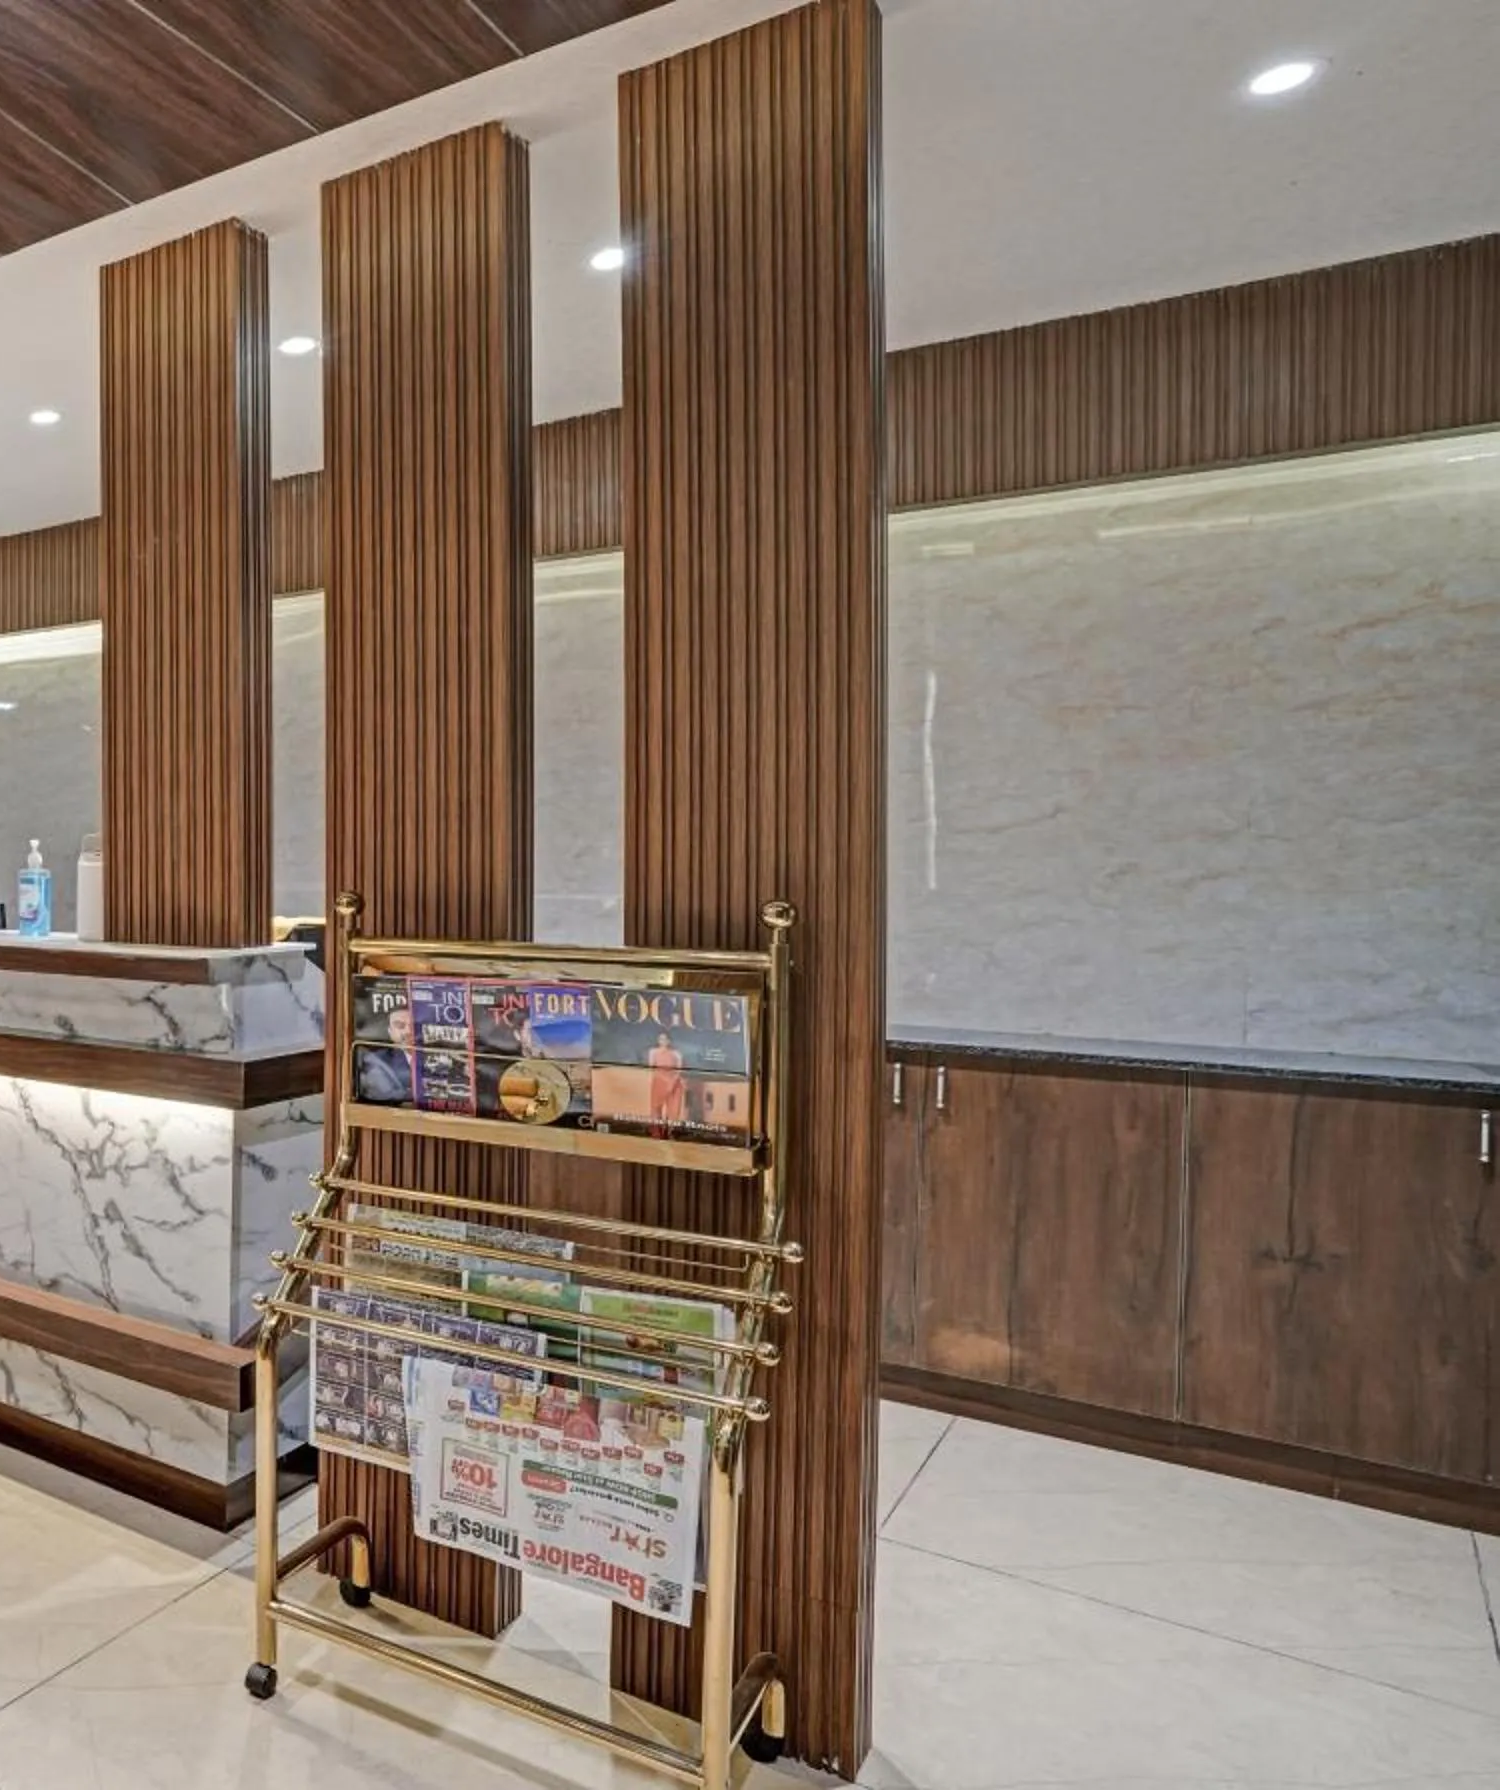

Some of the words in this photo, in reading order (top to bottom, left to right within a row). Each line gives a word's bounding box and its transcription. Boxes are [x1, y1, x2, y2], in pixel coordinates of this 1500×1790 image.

[428, 1003, 469, 1024] TO
[442, 990, 469, 1006] IN
[533, 992, 591, 1016] FORT
[595, 988, 742, 1033] VOGUE
[459, 1516, 521, 1560] Times
[523, 1539, 646, 1602] Bangalore
